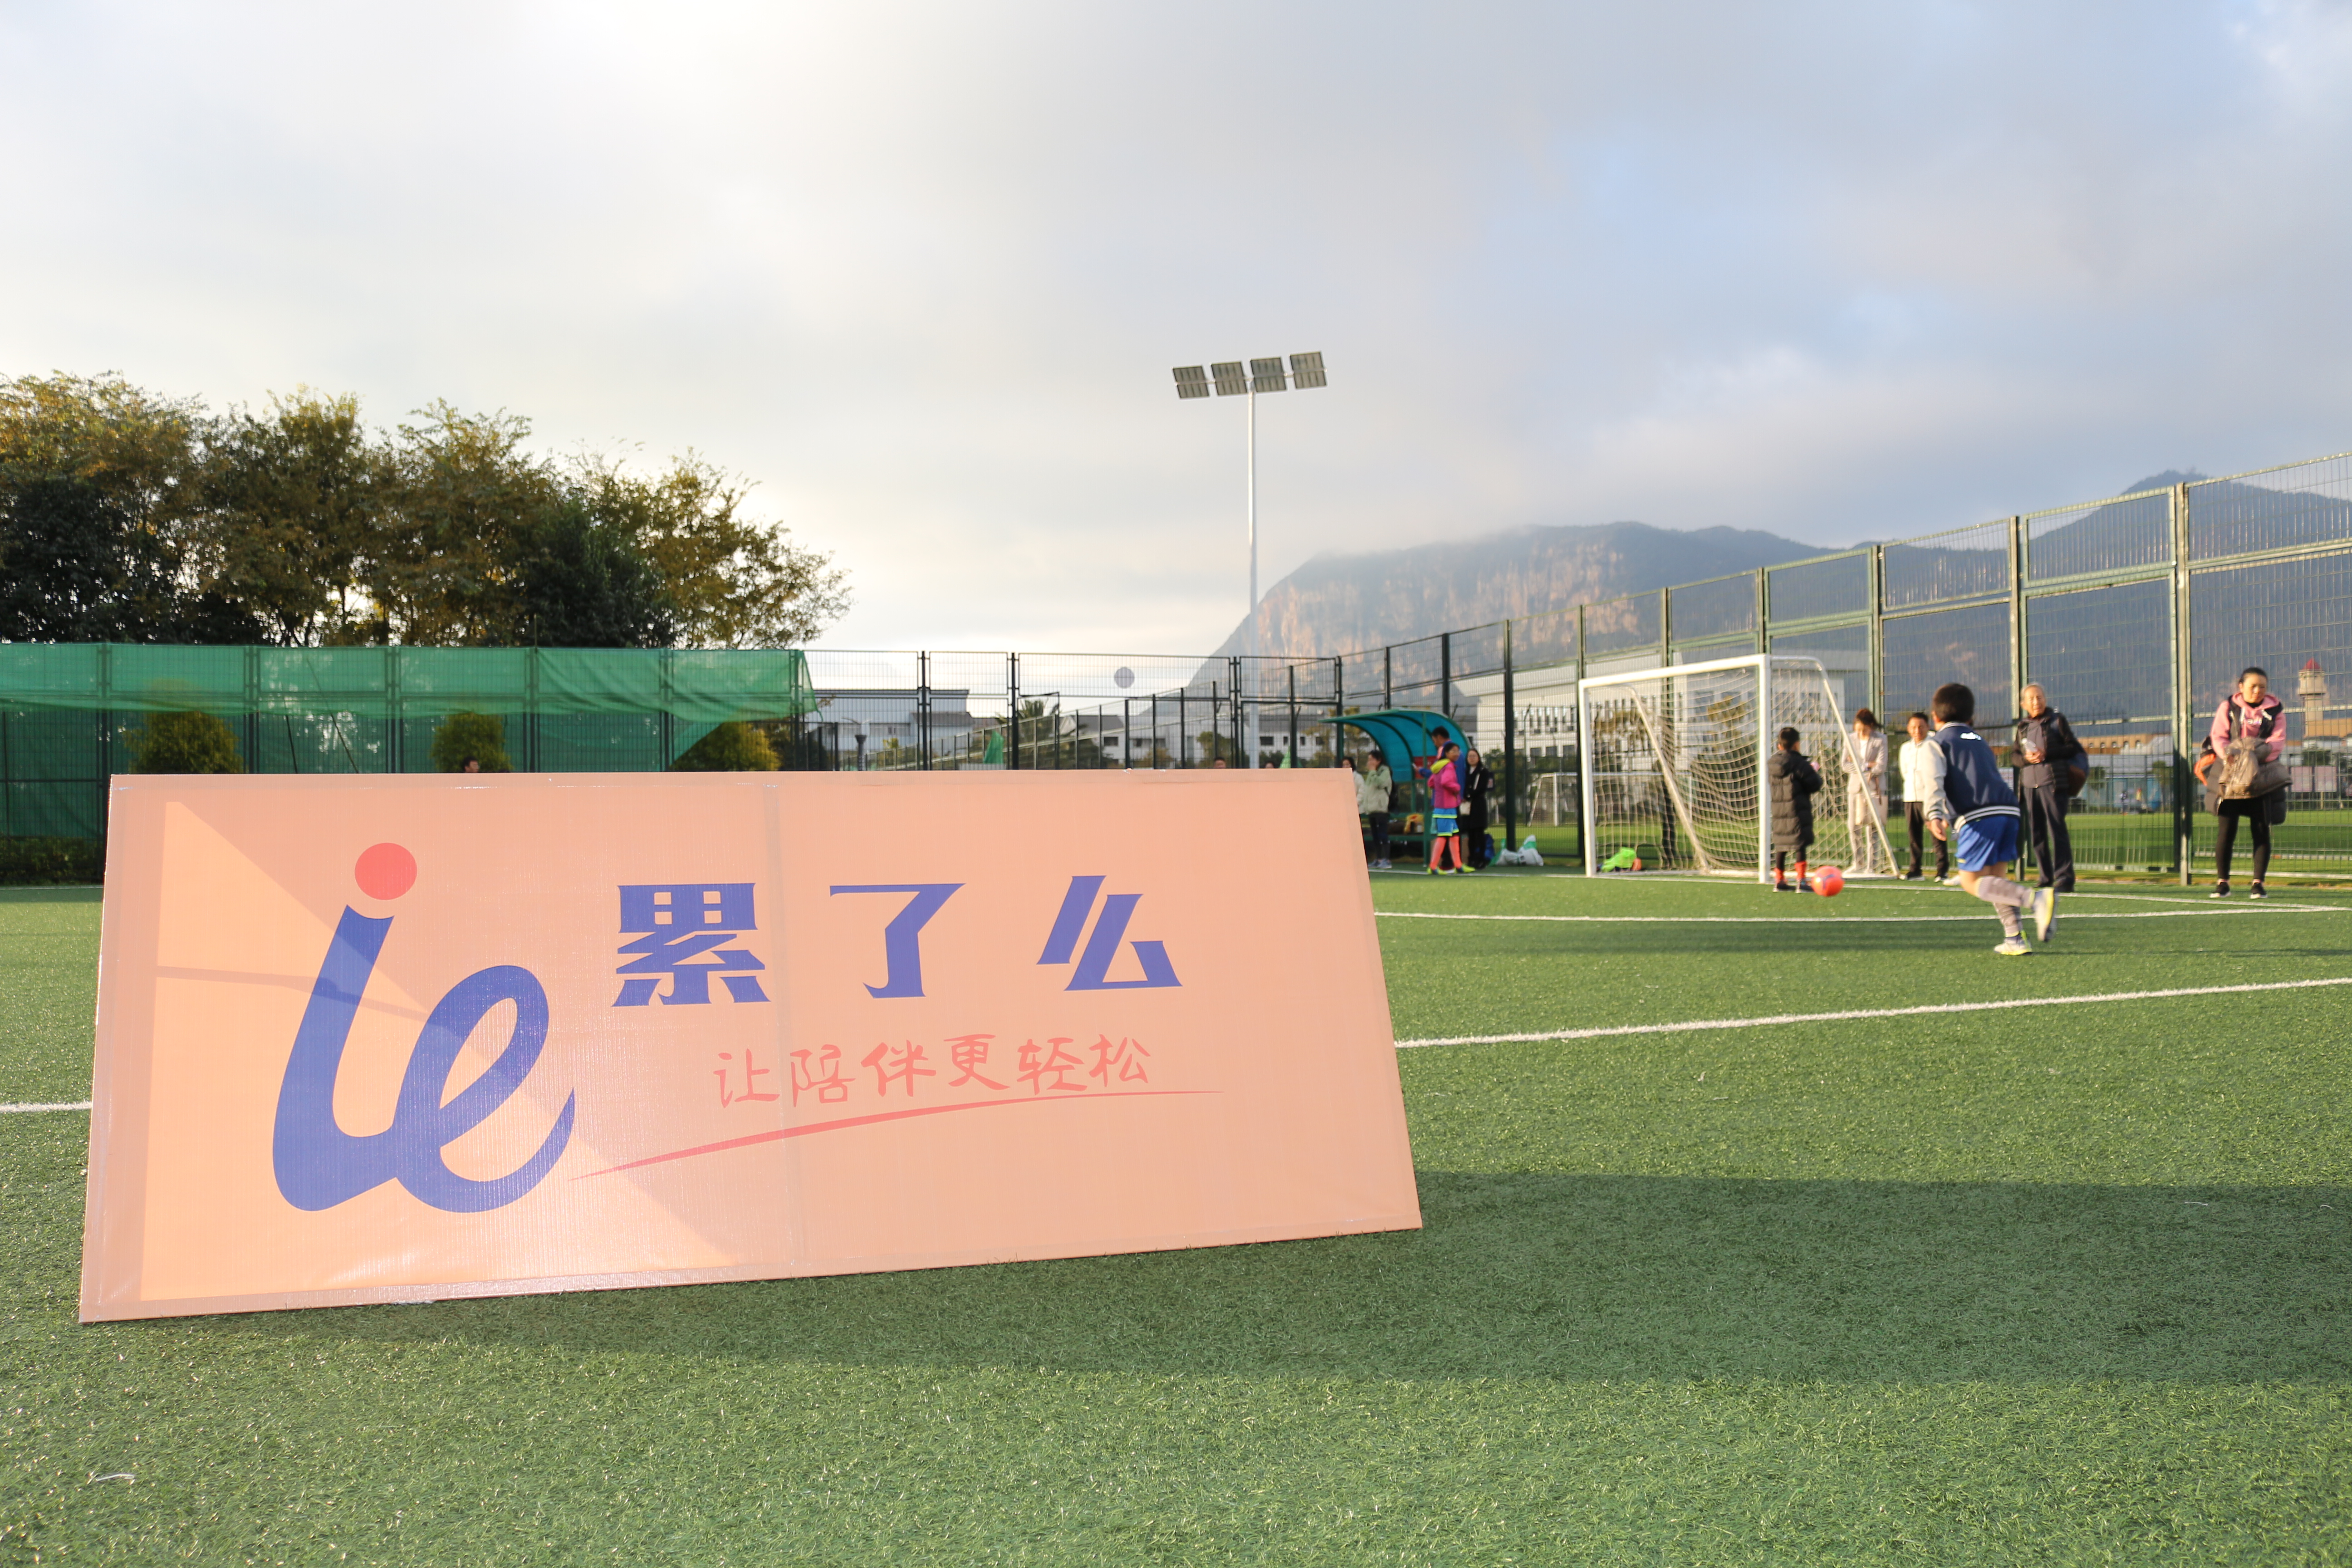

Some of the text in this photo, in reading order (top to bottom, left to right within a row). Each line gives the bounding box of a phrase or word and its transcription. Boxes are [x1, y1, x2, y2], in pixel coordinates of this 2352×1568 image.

[612, 875, 1182, 1007] 累了么
[714, 1034, 1151, 1108] 让陪伴更轻松
